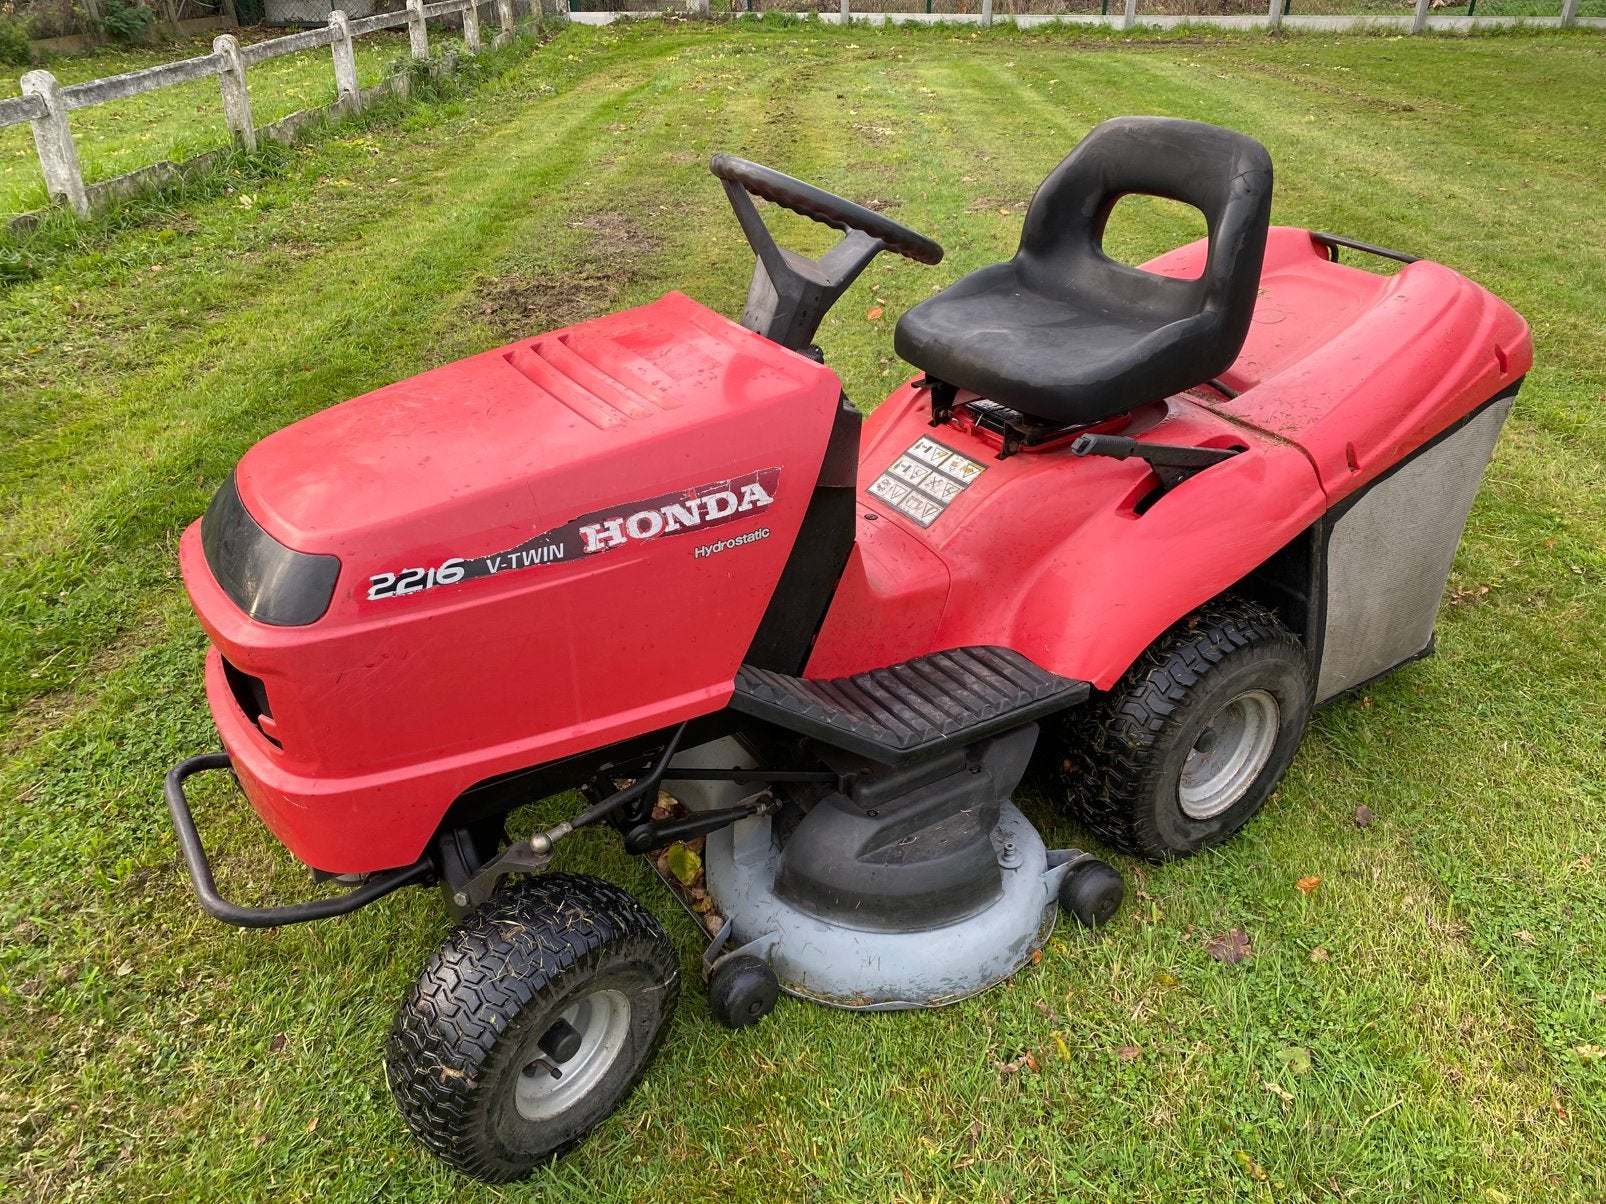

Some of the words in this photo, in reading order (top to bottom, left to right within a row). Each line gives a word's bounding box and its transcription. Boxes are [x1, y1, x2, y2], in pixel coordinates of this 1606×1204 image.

[367, 558, 465, 601] 2216
[486, 542, 565, 574] V-TWIN
[579, 482, 774, 553] HONDA
[694, 527, 770, 559] Hydrostatic
